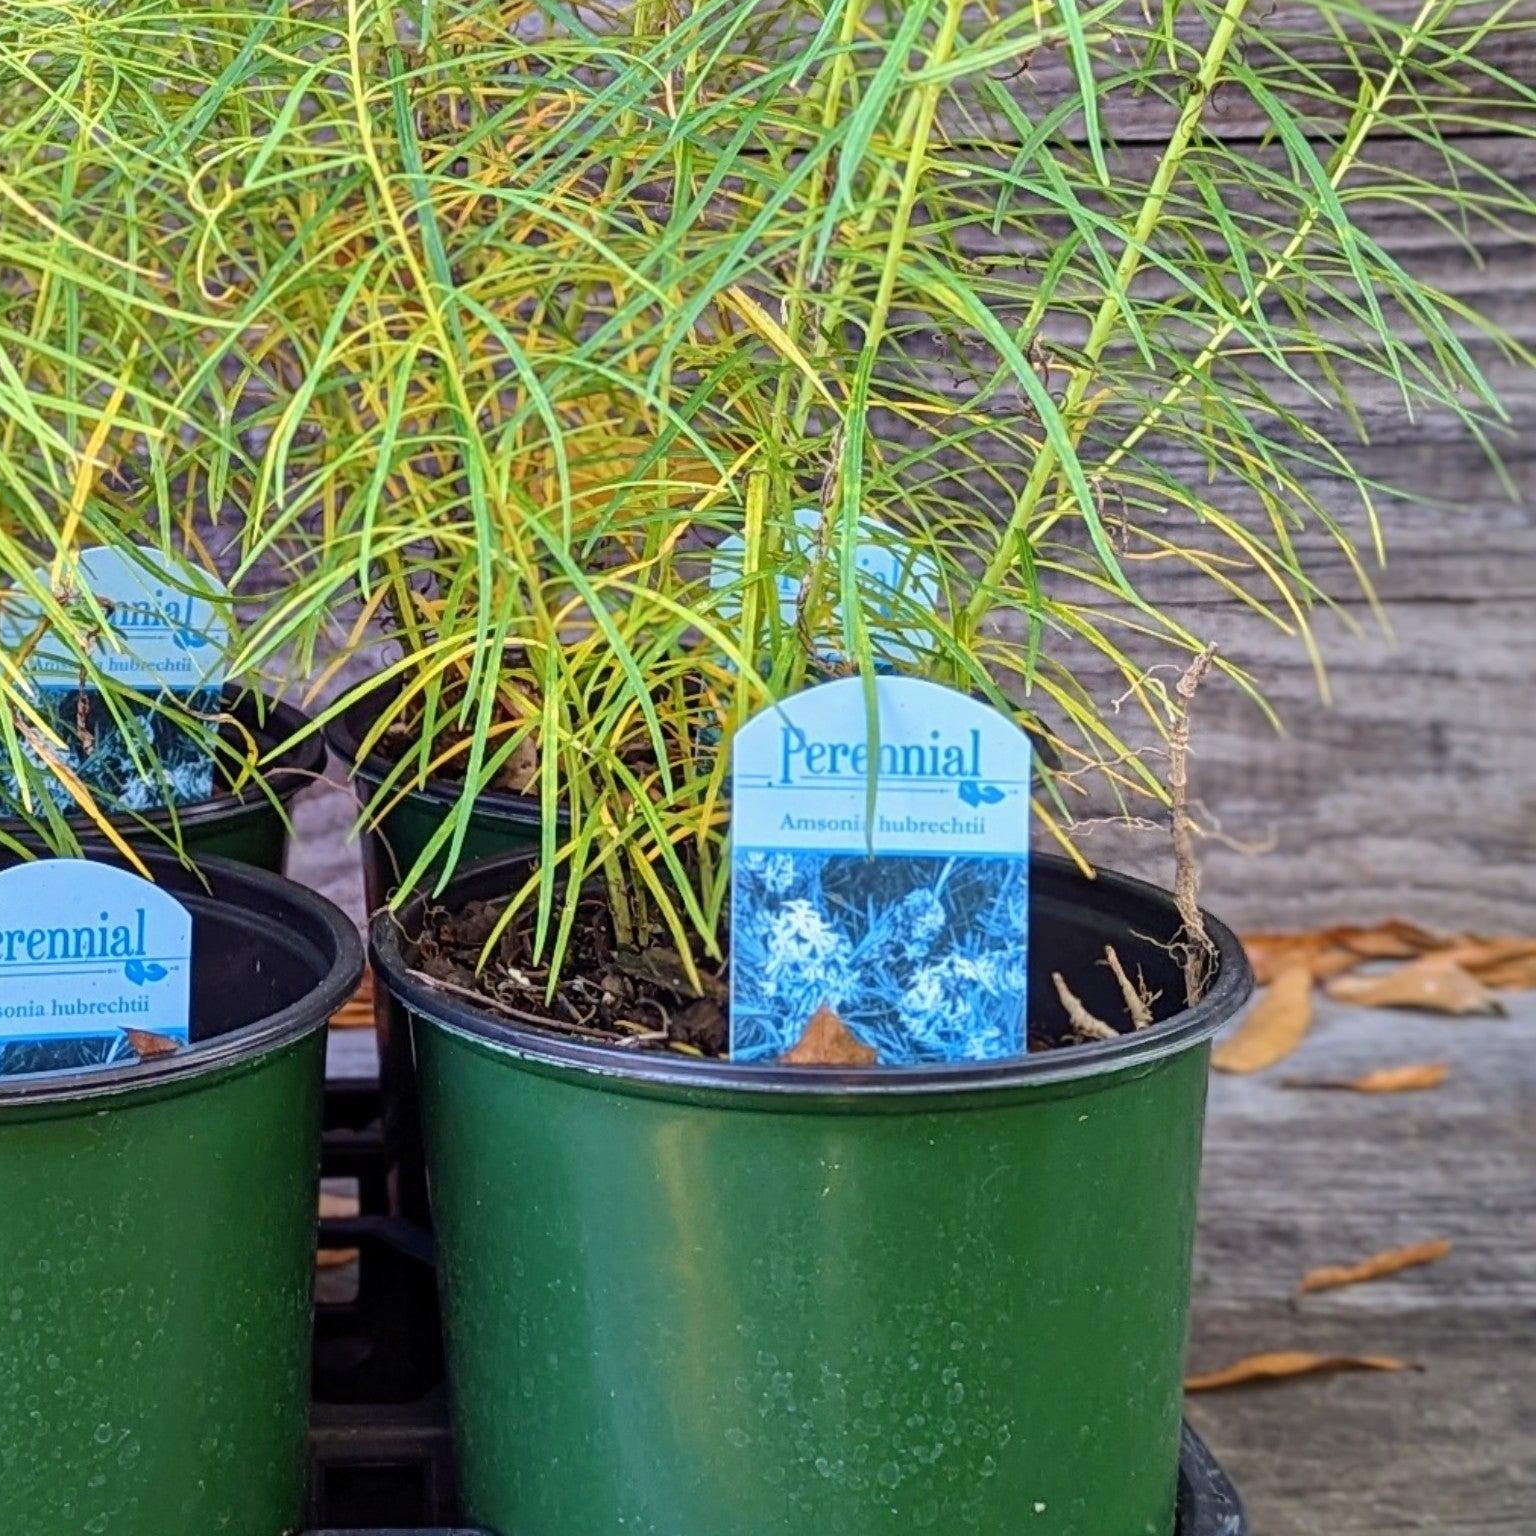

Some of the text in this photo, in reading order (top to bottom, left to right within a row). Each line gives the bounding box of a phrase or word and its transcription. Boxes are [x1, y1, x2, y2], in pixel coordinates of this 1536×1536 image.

[780, 727, 982, 784] Perennial
[779, 813, 985, 834] Amsoni hubrechtii
[51, 995, 150, 1016] hubrechtii
